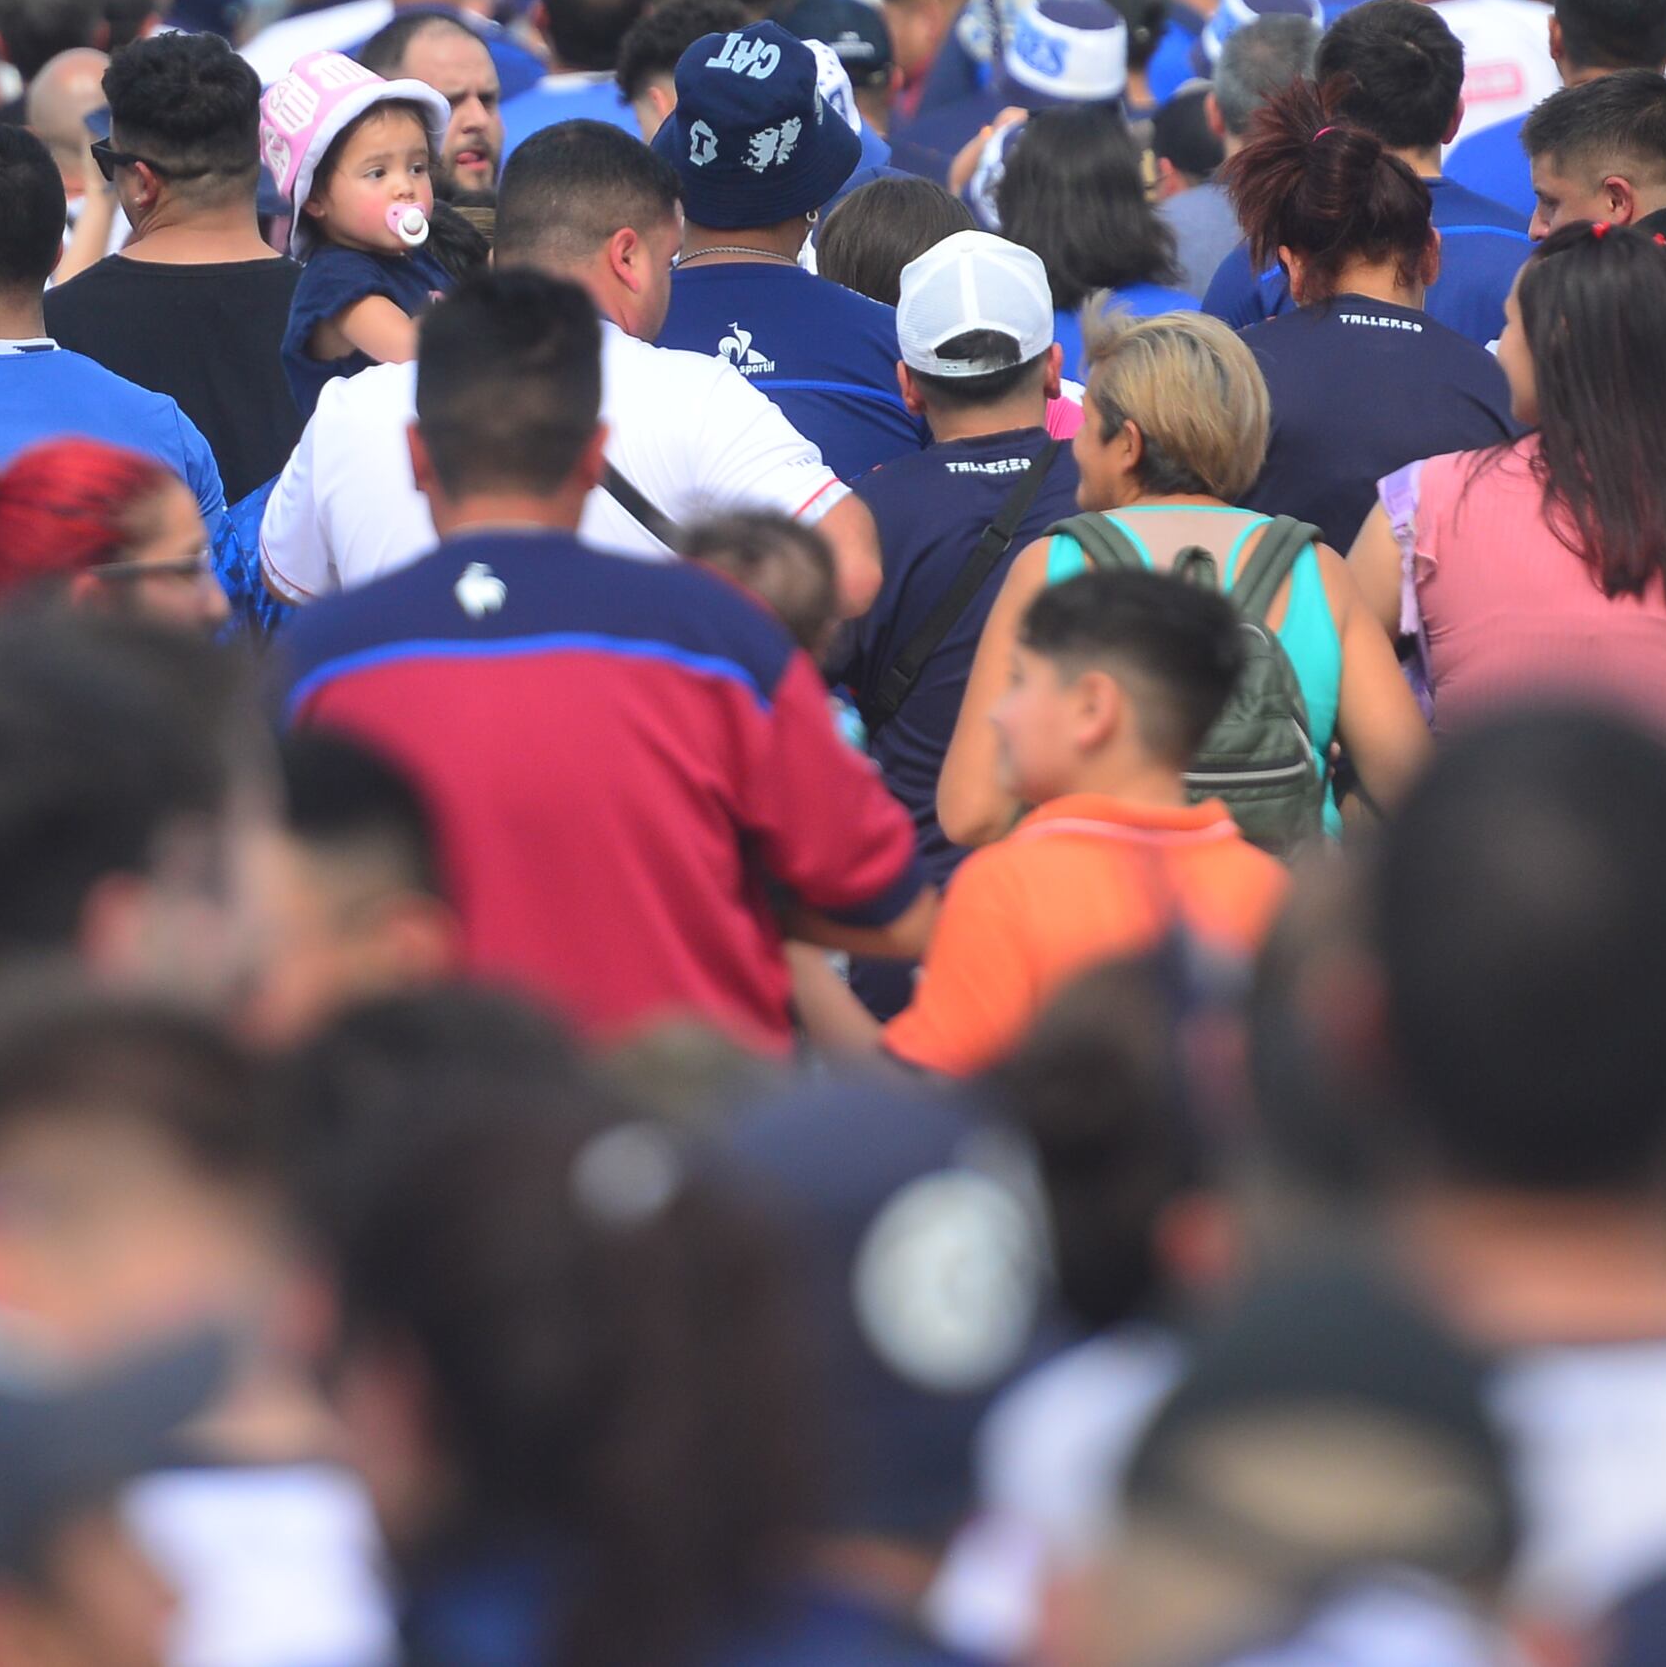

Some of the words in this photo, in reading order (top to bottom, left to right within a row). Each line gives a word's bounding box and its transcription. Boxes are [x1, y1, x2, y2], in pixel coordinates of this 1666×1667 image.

[1339, 314, 1423, 333] TALLERES
[739, 360, 776, 377] sportif
[945, 458, 1032, 474] TALLERES
